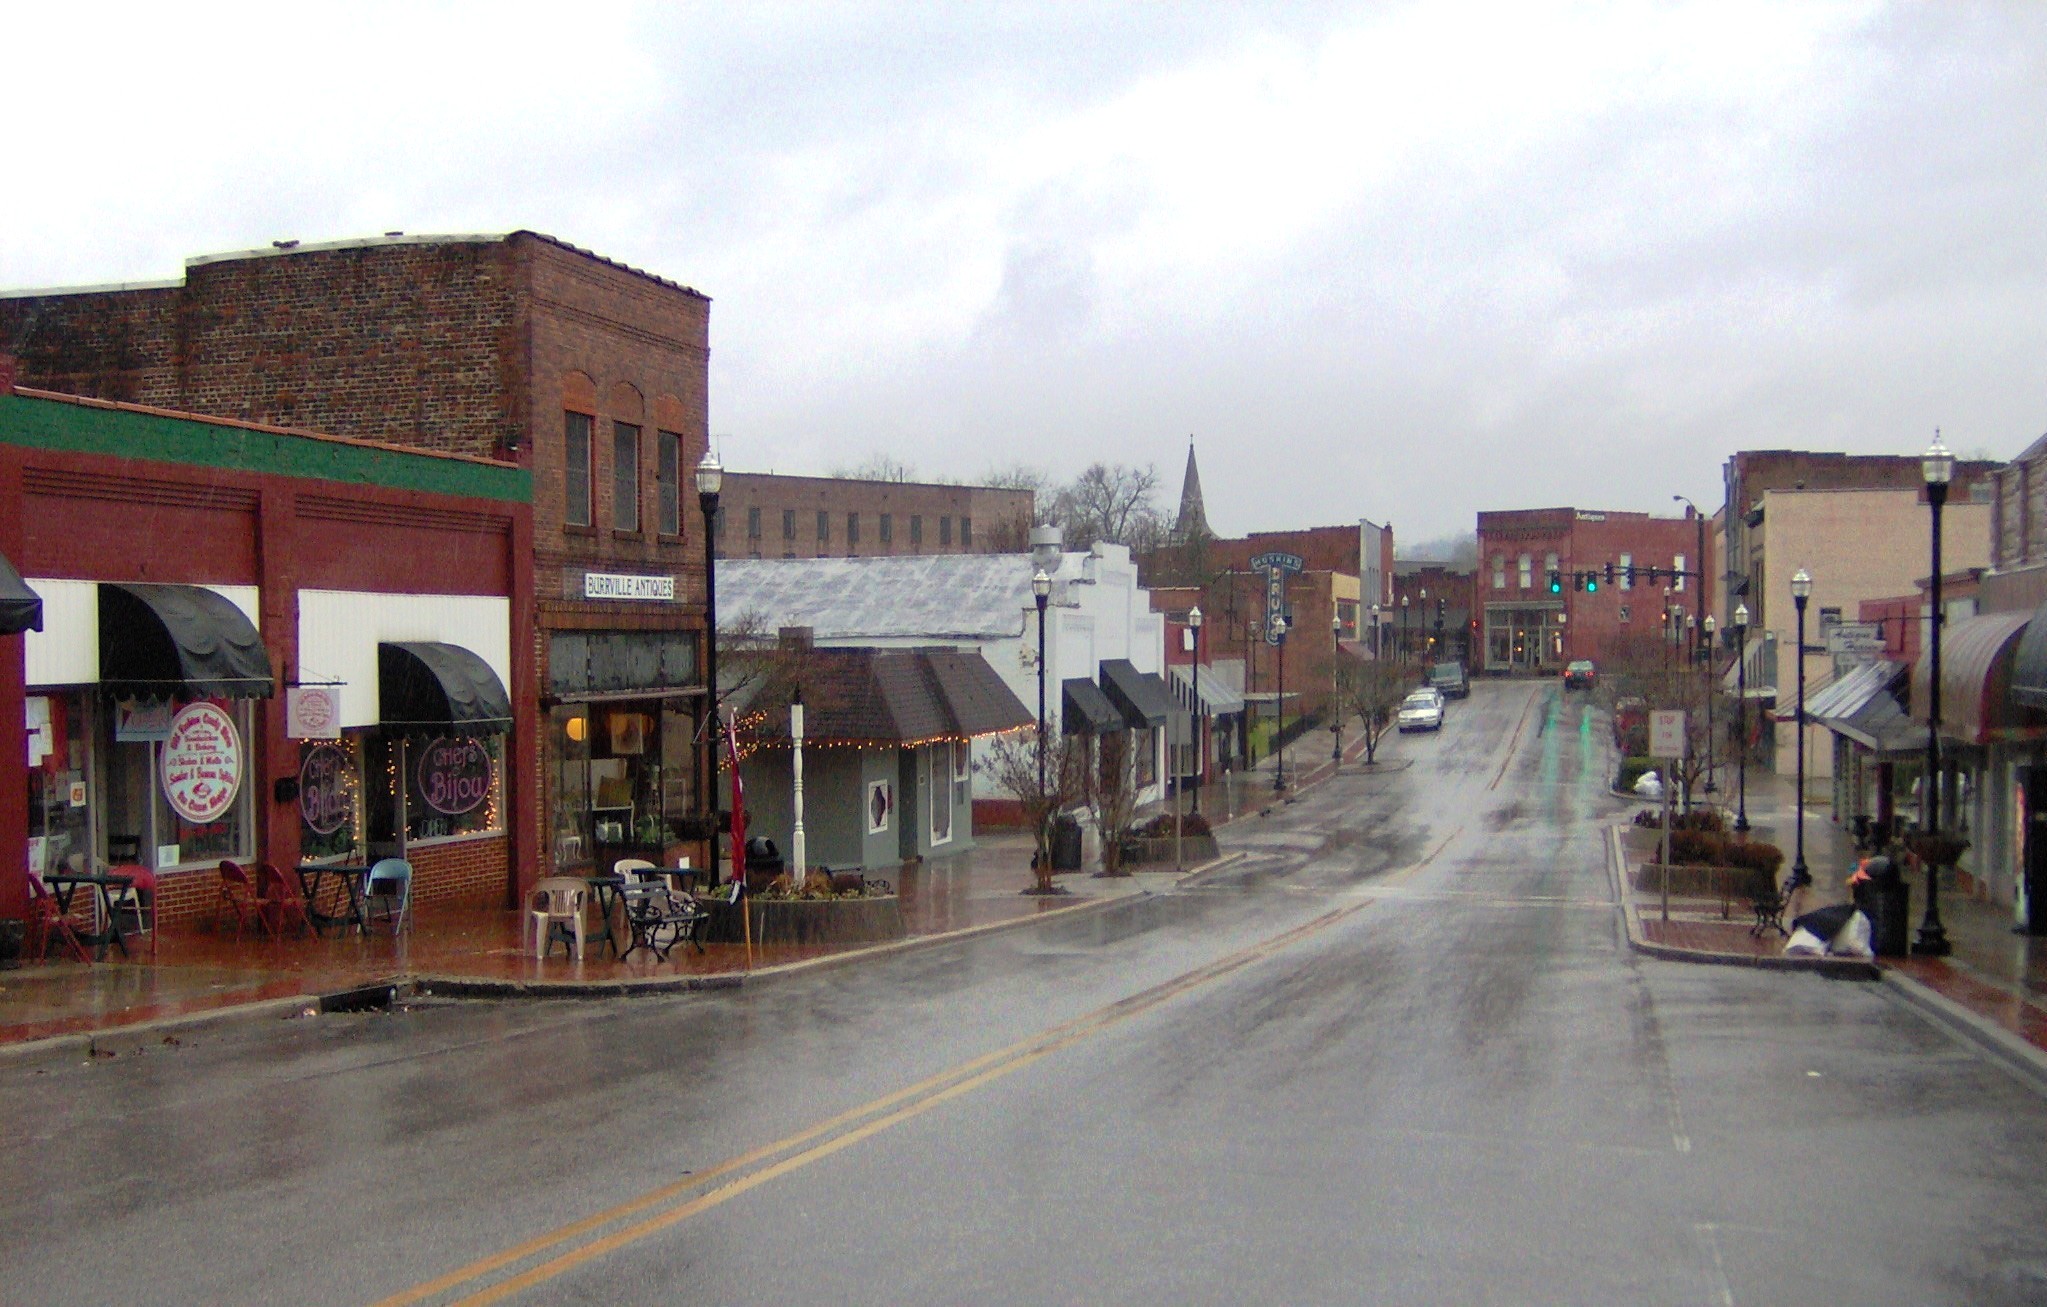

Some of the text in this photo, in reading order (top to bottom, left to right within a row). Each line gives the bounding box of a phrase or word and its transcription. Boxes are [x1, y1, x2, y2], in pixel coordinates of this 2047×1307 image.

[1254, 555, 1300, 568] HOSKINS
[588, 576, 672, 597] BURRVILLE ANTIQUES
[430, 771, 483, 807] Bijou
